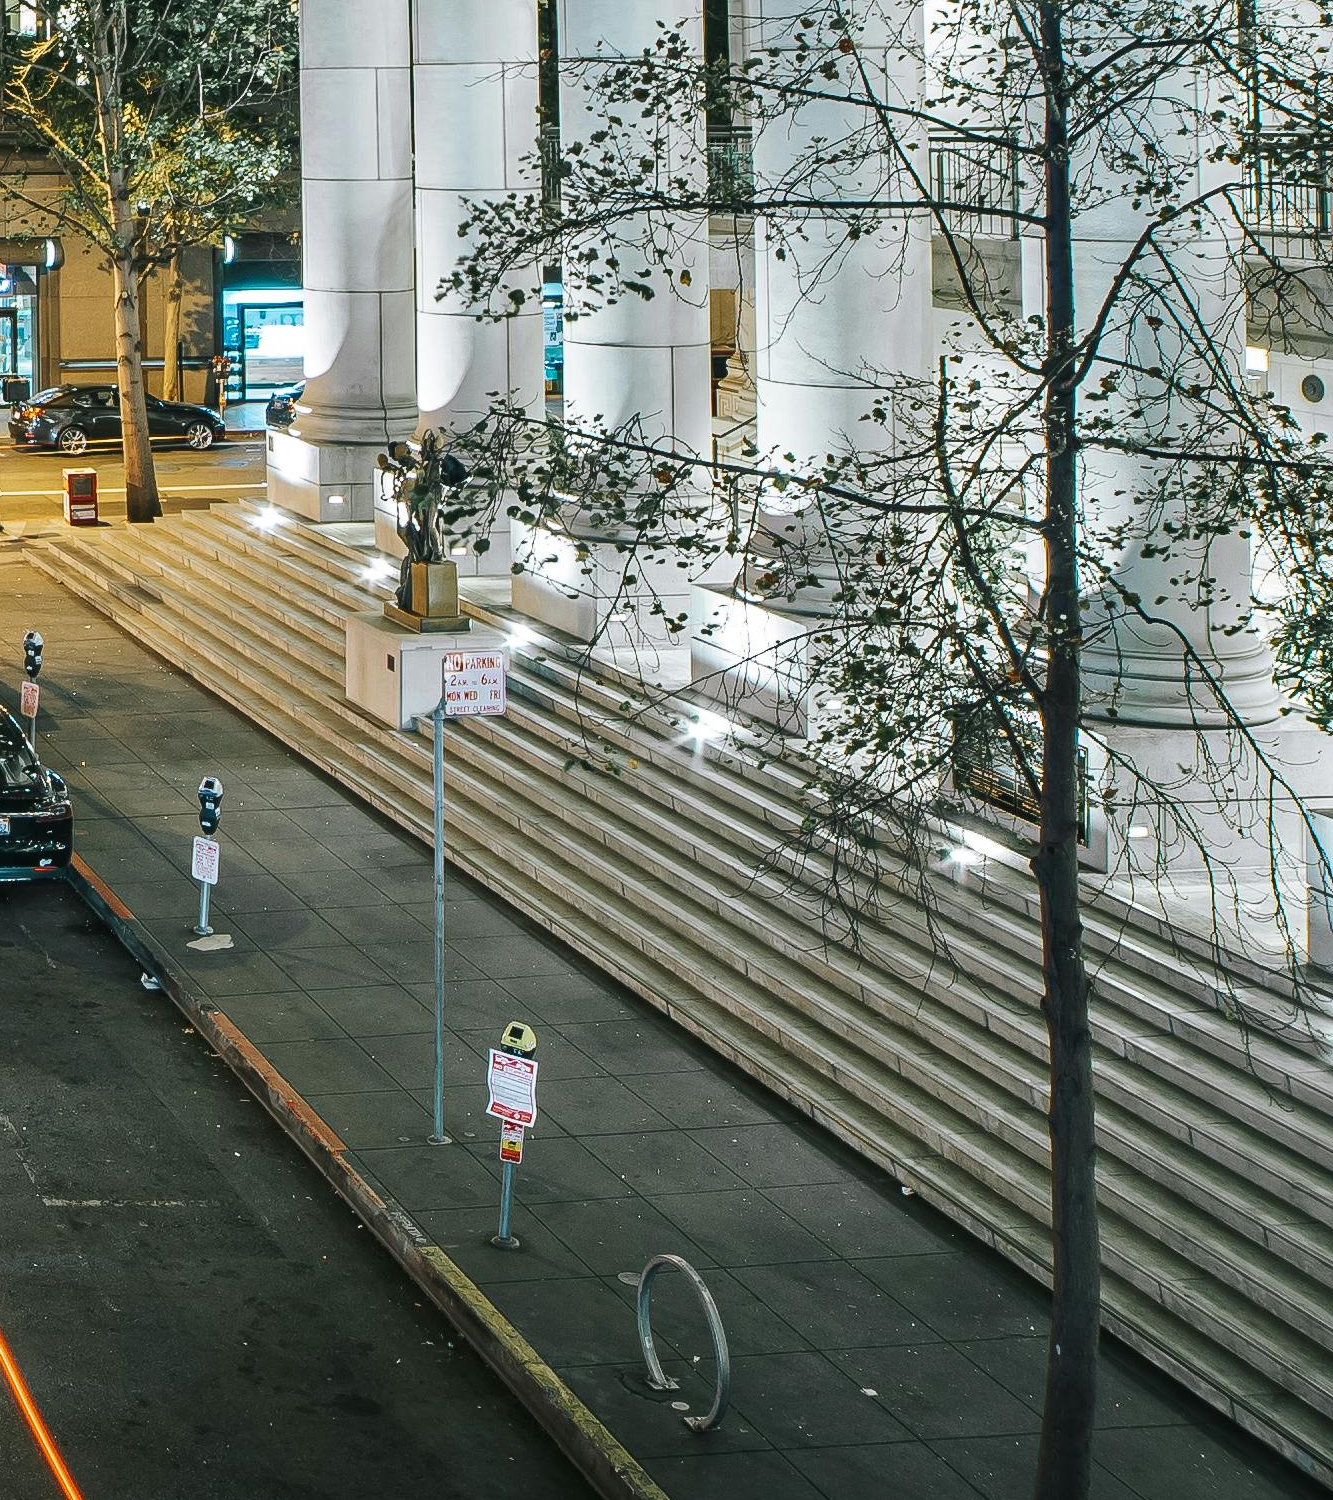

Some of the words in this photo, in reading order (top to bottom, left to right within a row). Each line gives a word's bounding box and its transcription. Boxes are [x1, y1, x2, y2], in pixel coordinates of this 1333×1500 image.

[446, 653, 462, 670] NO
[465, 656, 501, 669] PARKING
[446, 691, 461, 701] MON
[464, 690, 478, 700] WED
[489, 689, 501, 700] FRI
